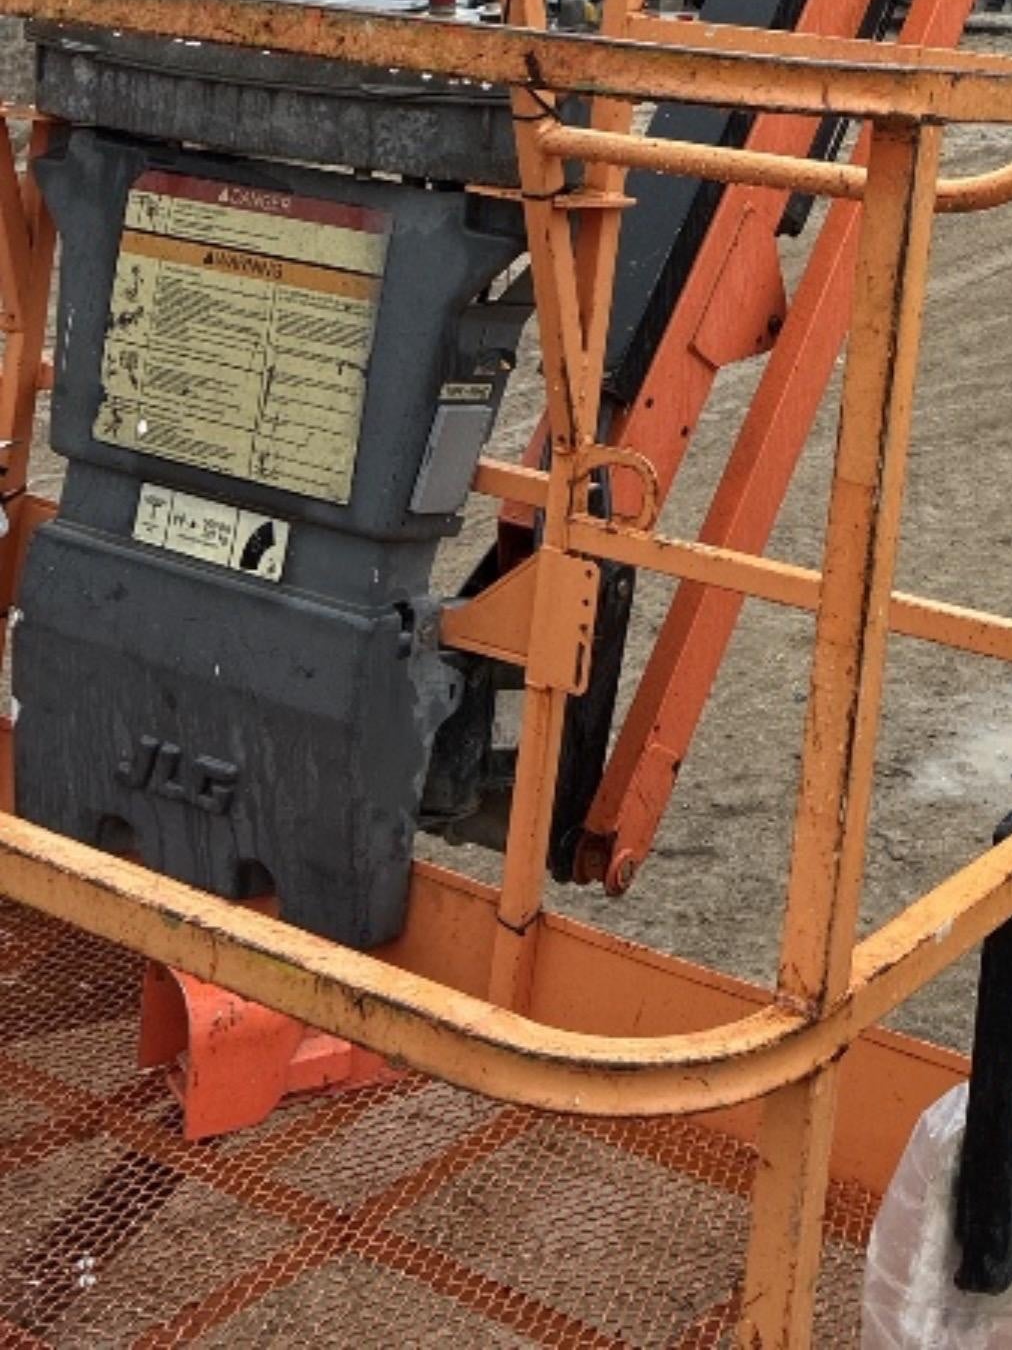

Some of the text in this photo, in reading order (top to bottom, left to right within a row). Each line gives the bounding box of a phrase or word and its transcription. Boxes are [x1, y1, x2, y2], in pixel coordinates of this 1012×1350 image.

[229, 191, 292, 210] DANGER
[214, 251, 283, 278] WARNING
[113, 735, 239, 817] JLG
